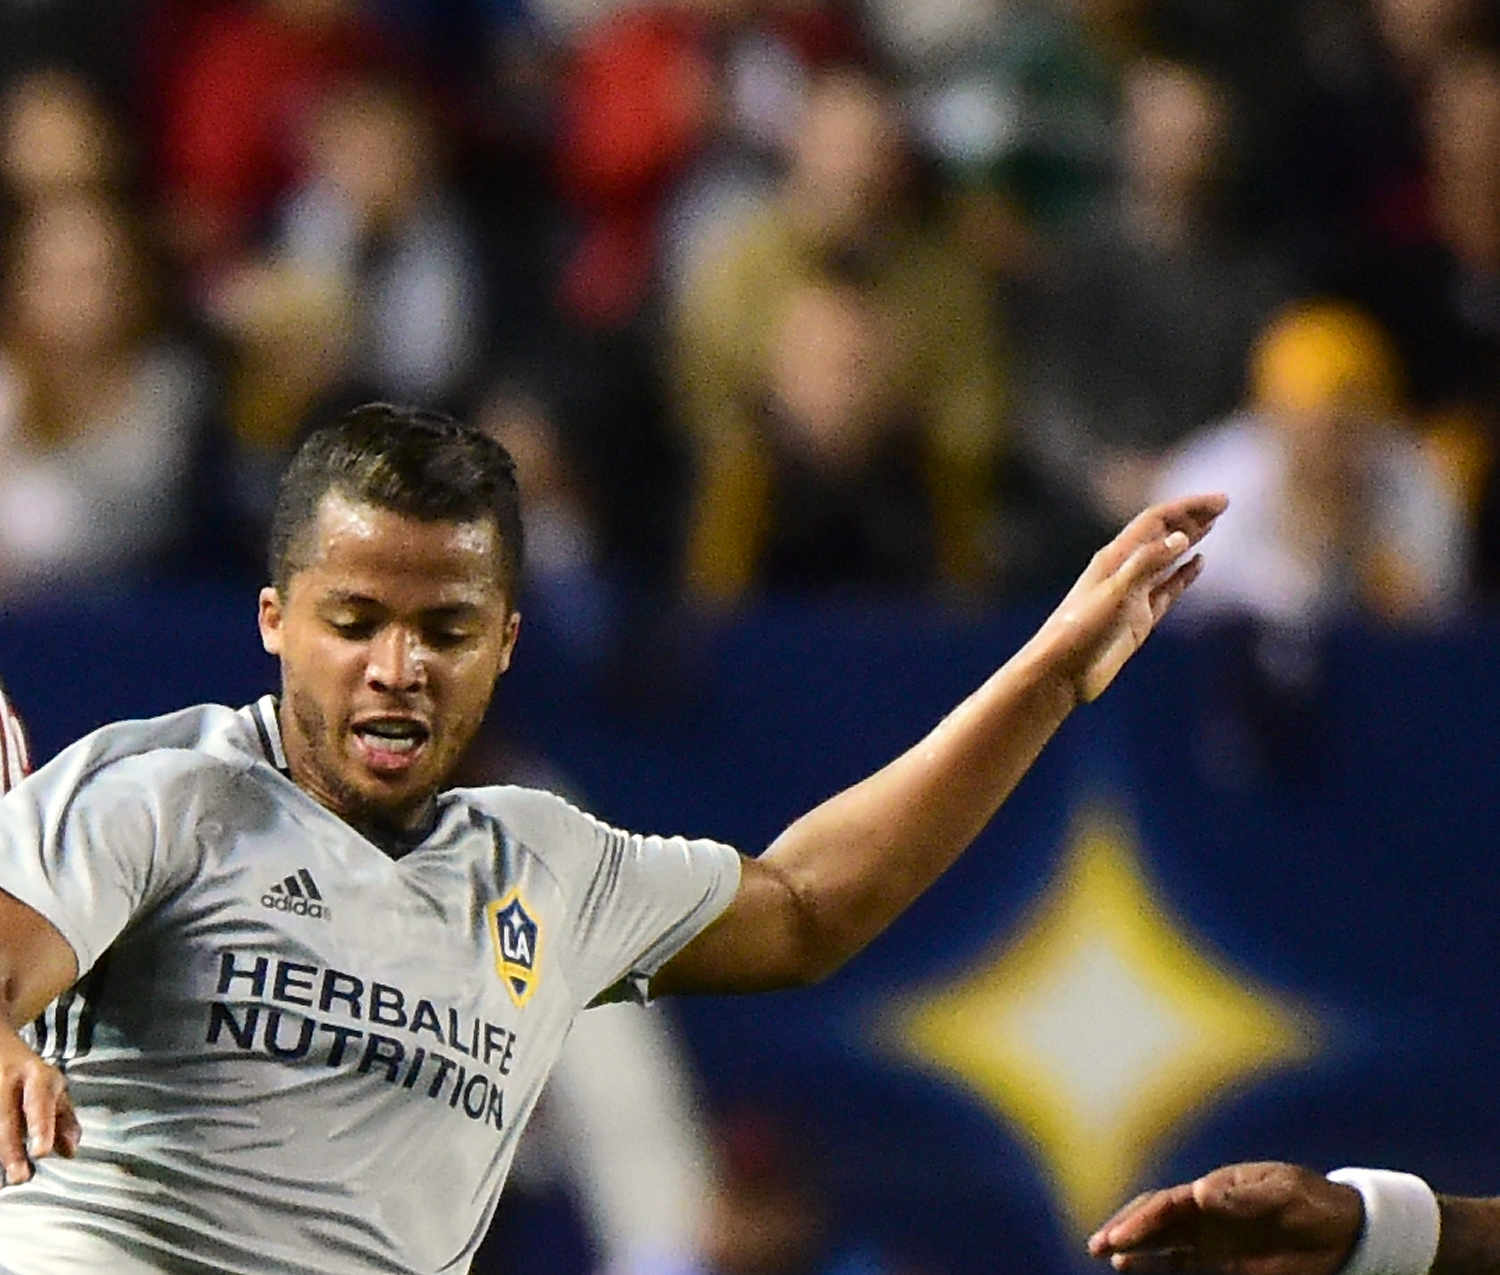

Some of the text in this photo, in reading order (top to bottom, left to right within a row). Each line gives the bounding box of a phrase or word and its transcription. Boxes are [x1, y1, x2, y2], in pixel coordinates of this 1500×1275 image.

[503, 924, 531, 965] LA
[205, 1001, 504, 1132] NUTRITION
[216, 951, 517, 1077] HERBALIFE
